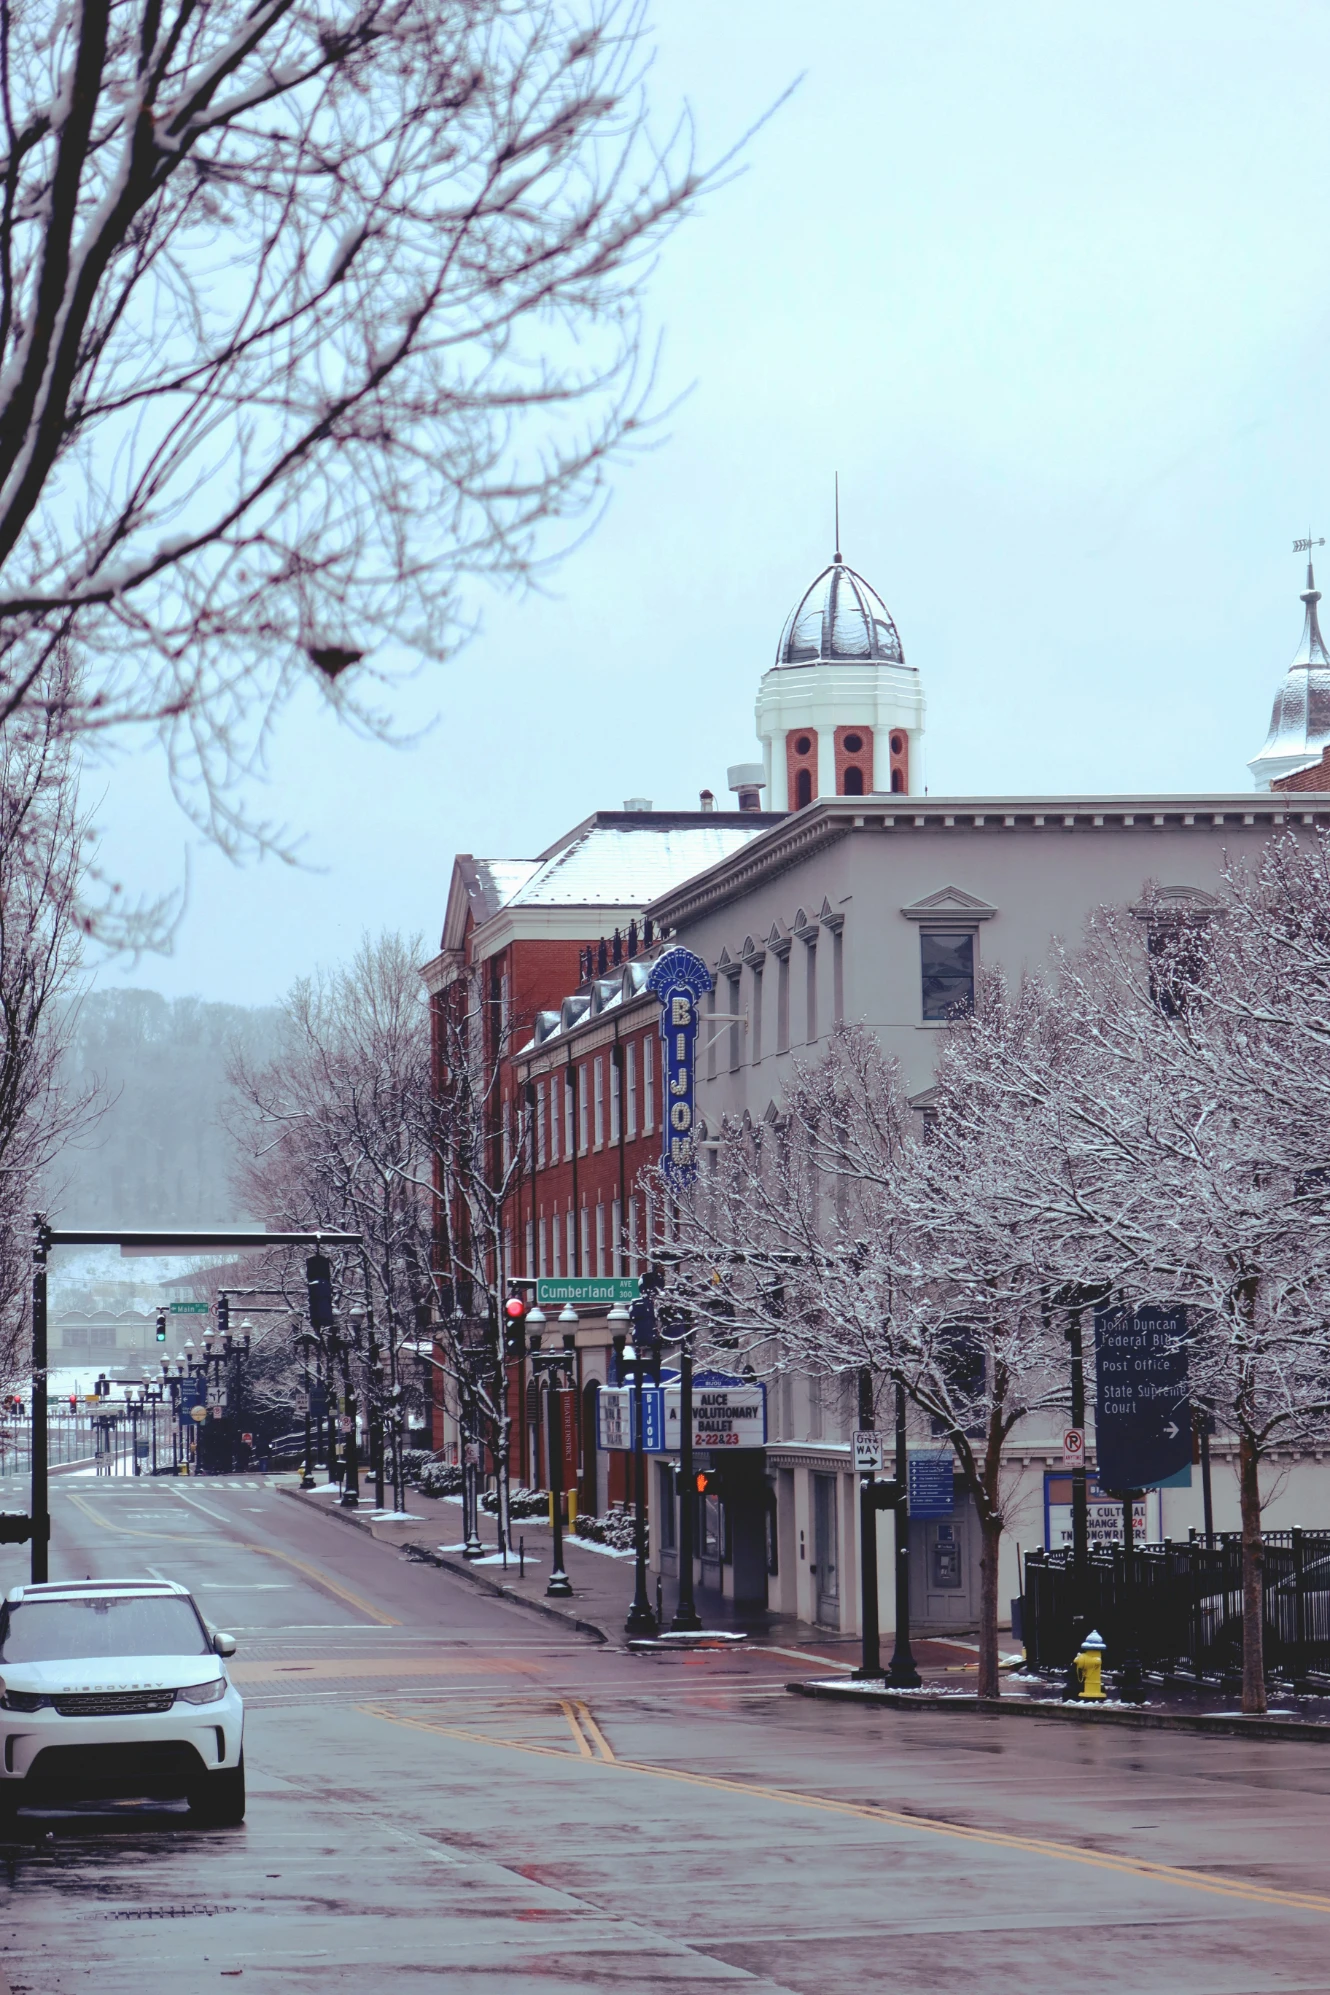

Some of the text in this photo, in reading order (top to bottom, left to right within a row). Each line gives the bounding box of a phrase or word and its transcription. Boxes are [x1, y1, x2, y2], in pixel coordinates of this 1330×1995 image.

[670, 997, 691, 1165] BIJOU
[541, 1285, 614, 1298] Cumberland
[177, 1305, 195, 1313] Main
[1133, 1319, 1177, 1331] Duncan
[1103, 1360, 1170, 1371] Post Office
[1104, 1385, 1187, 1400] State Supreme
[701, 1393, 728, 1406] ALICE
[669, 1407, 758, 1420] A VOLUTIONARY
[1104, 1401, 1136, 1414] Court
[698, 1420, 733, 1432] BALLET
[695, 1433, 739, 1446] 2-22&23
[856, 1433, 879, 1444] ONE
[856, 1445, 879, 1455] WAY
[1097, 1507, 1146, 1518] CULTAL
[63, 1683, 163, 1692] DISCOVERY
